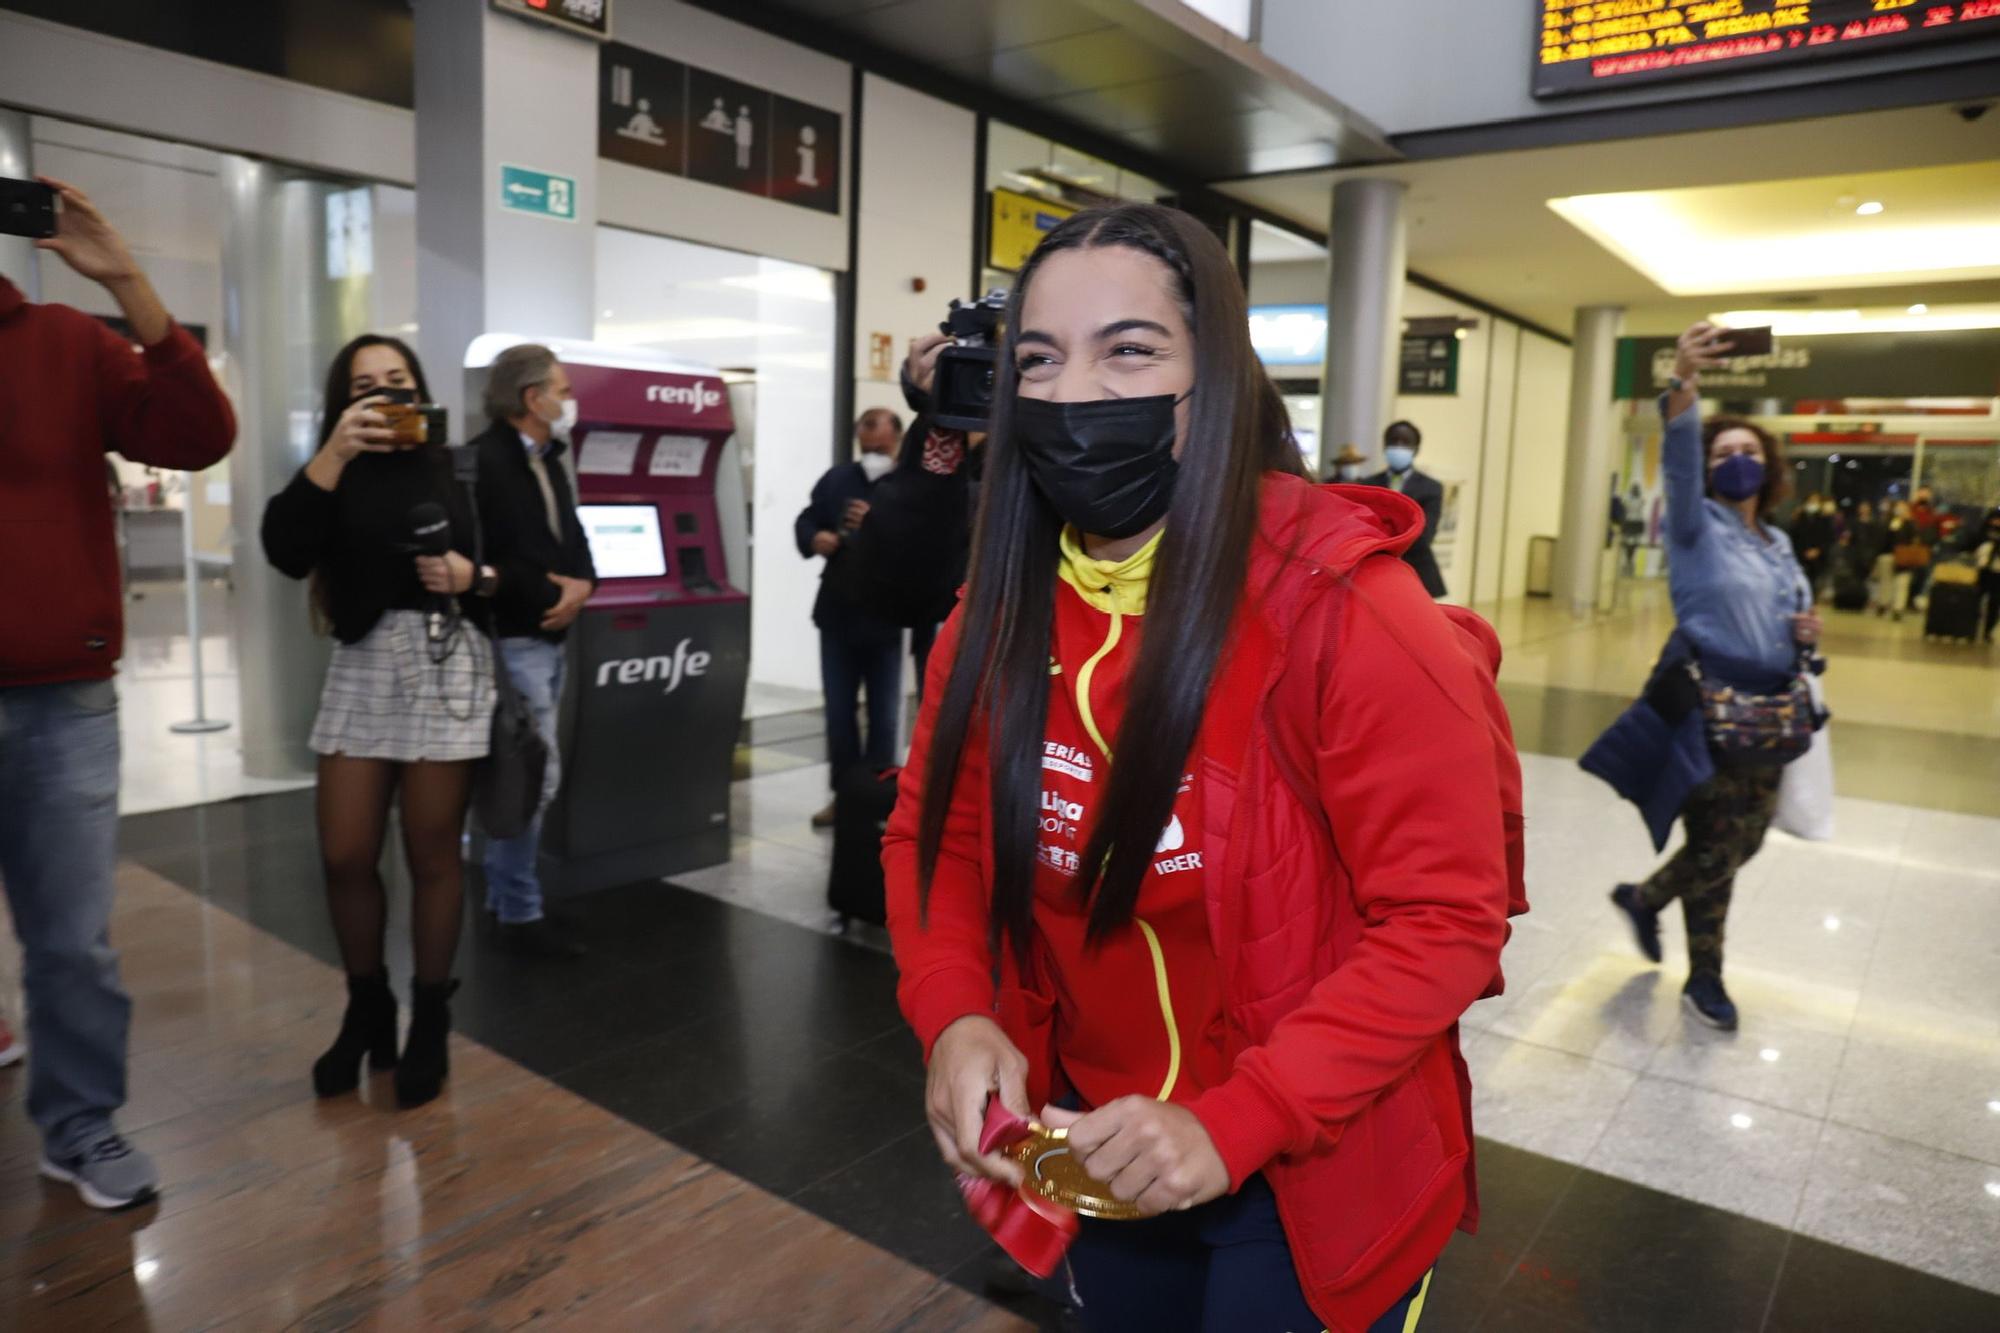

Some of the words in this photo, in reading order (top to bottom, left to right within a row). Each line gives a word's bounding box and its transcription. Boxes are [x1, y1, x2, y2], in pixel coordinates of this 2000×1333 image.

[646, 380, 722, 413] renfe
[596, 638, 711, 695] renfe
[1043, 741, 1093, 768] ERÍAS
[1154, 851, 1203, 876] IBER
